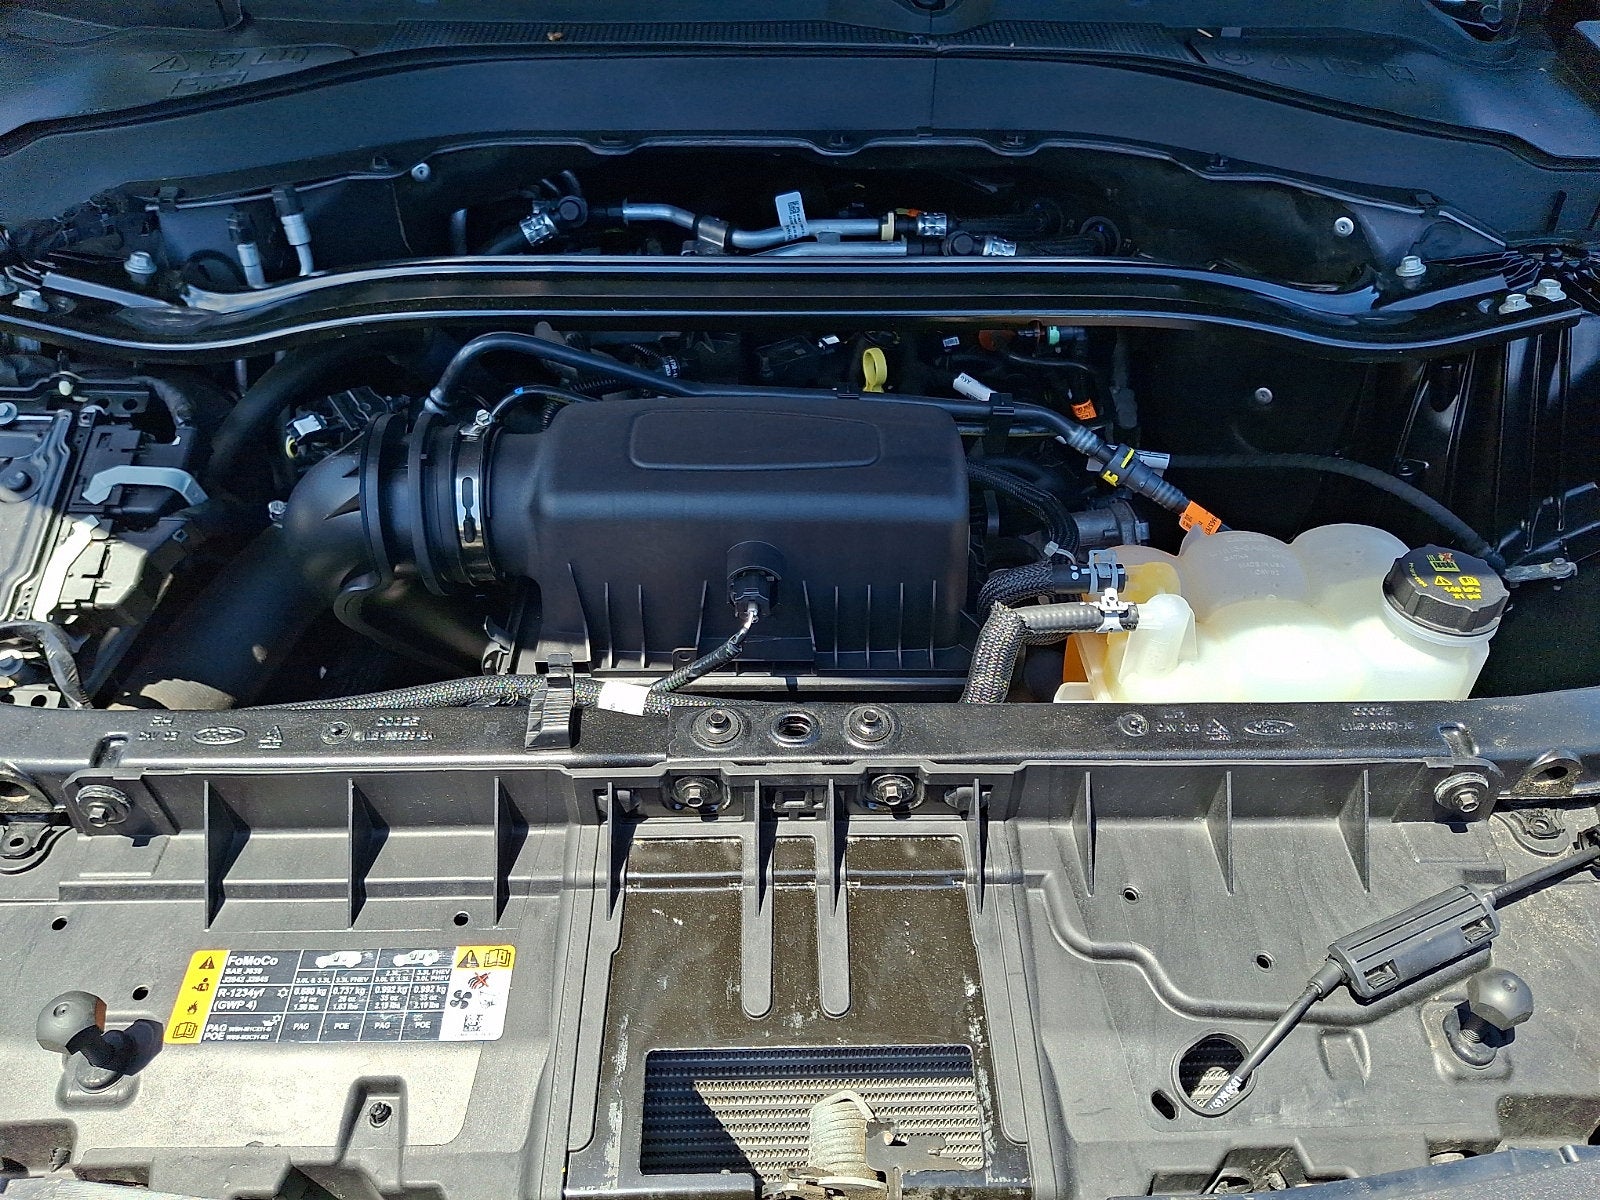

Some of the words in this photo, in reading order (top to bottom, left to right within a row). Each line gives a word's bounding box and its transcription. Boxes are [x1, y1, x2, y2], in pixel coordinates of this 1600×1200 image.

[227, 955, 279, 966] FoMoCo
[217, 987, 266, 999] R-1234yf
[316, 987, 328, 997] kg
[333, 986, 354, 995] 0.737
[354, 986, 366, 996] kg
[374, 985, 397, 994] 0.992
[396, 985, 409, 995] kg
[413, 985, 435, 994] 0.992
[435, 985, 447, 995] kg
[213, 1000, 245, 1012] (GWP
[245, 1000, 258, 1011] 4)
[206, 1023, 228, 1032] PAG
[292, 1022, 310, 1030] PAG
[333, 1022, 351, 1030] POE
[374, 1021, 391, 1029] PAG
[415, 1021, 432, 1029] POE
[203, 1032, 226, 1040] POE
